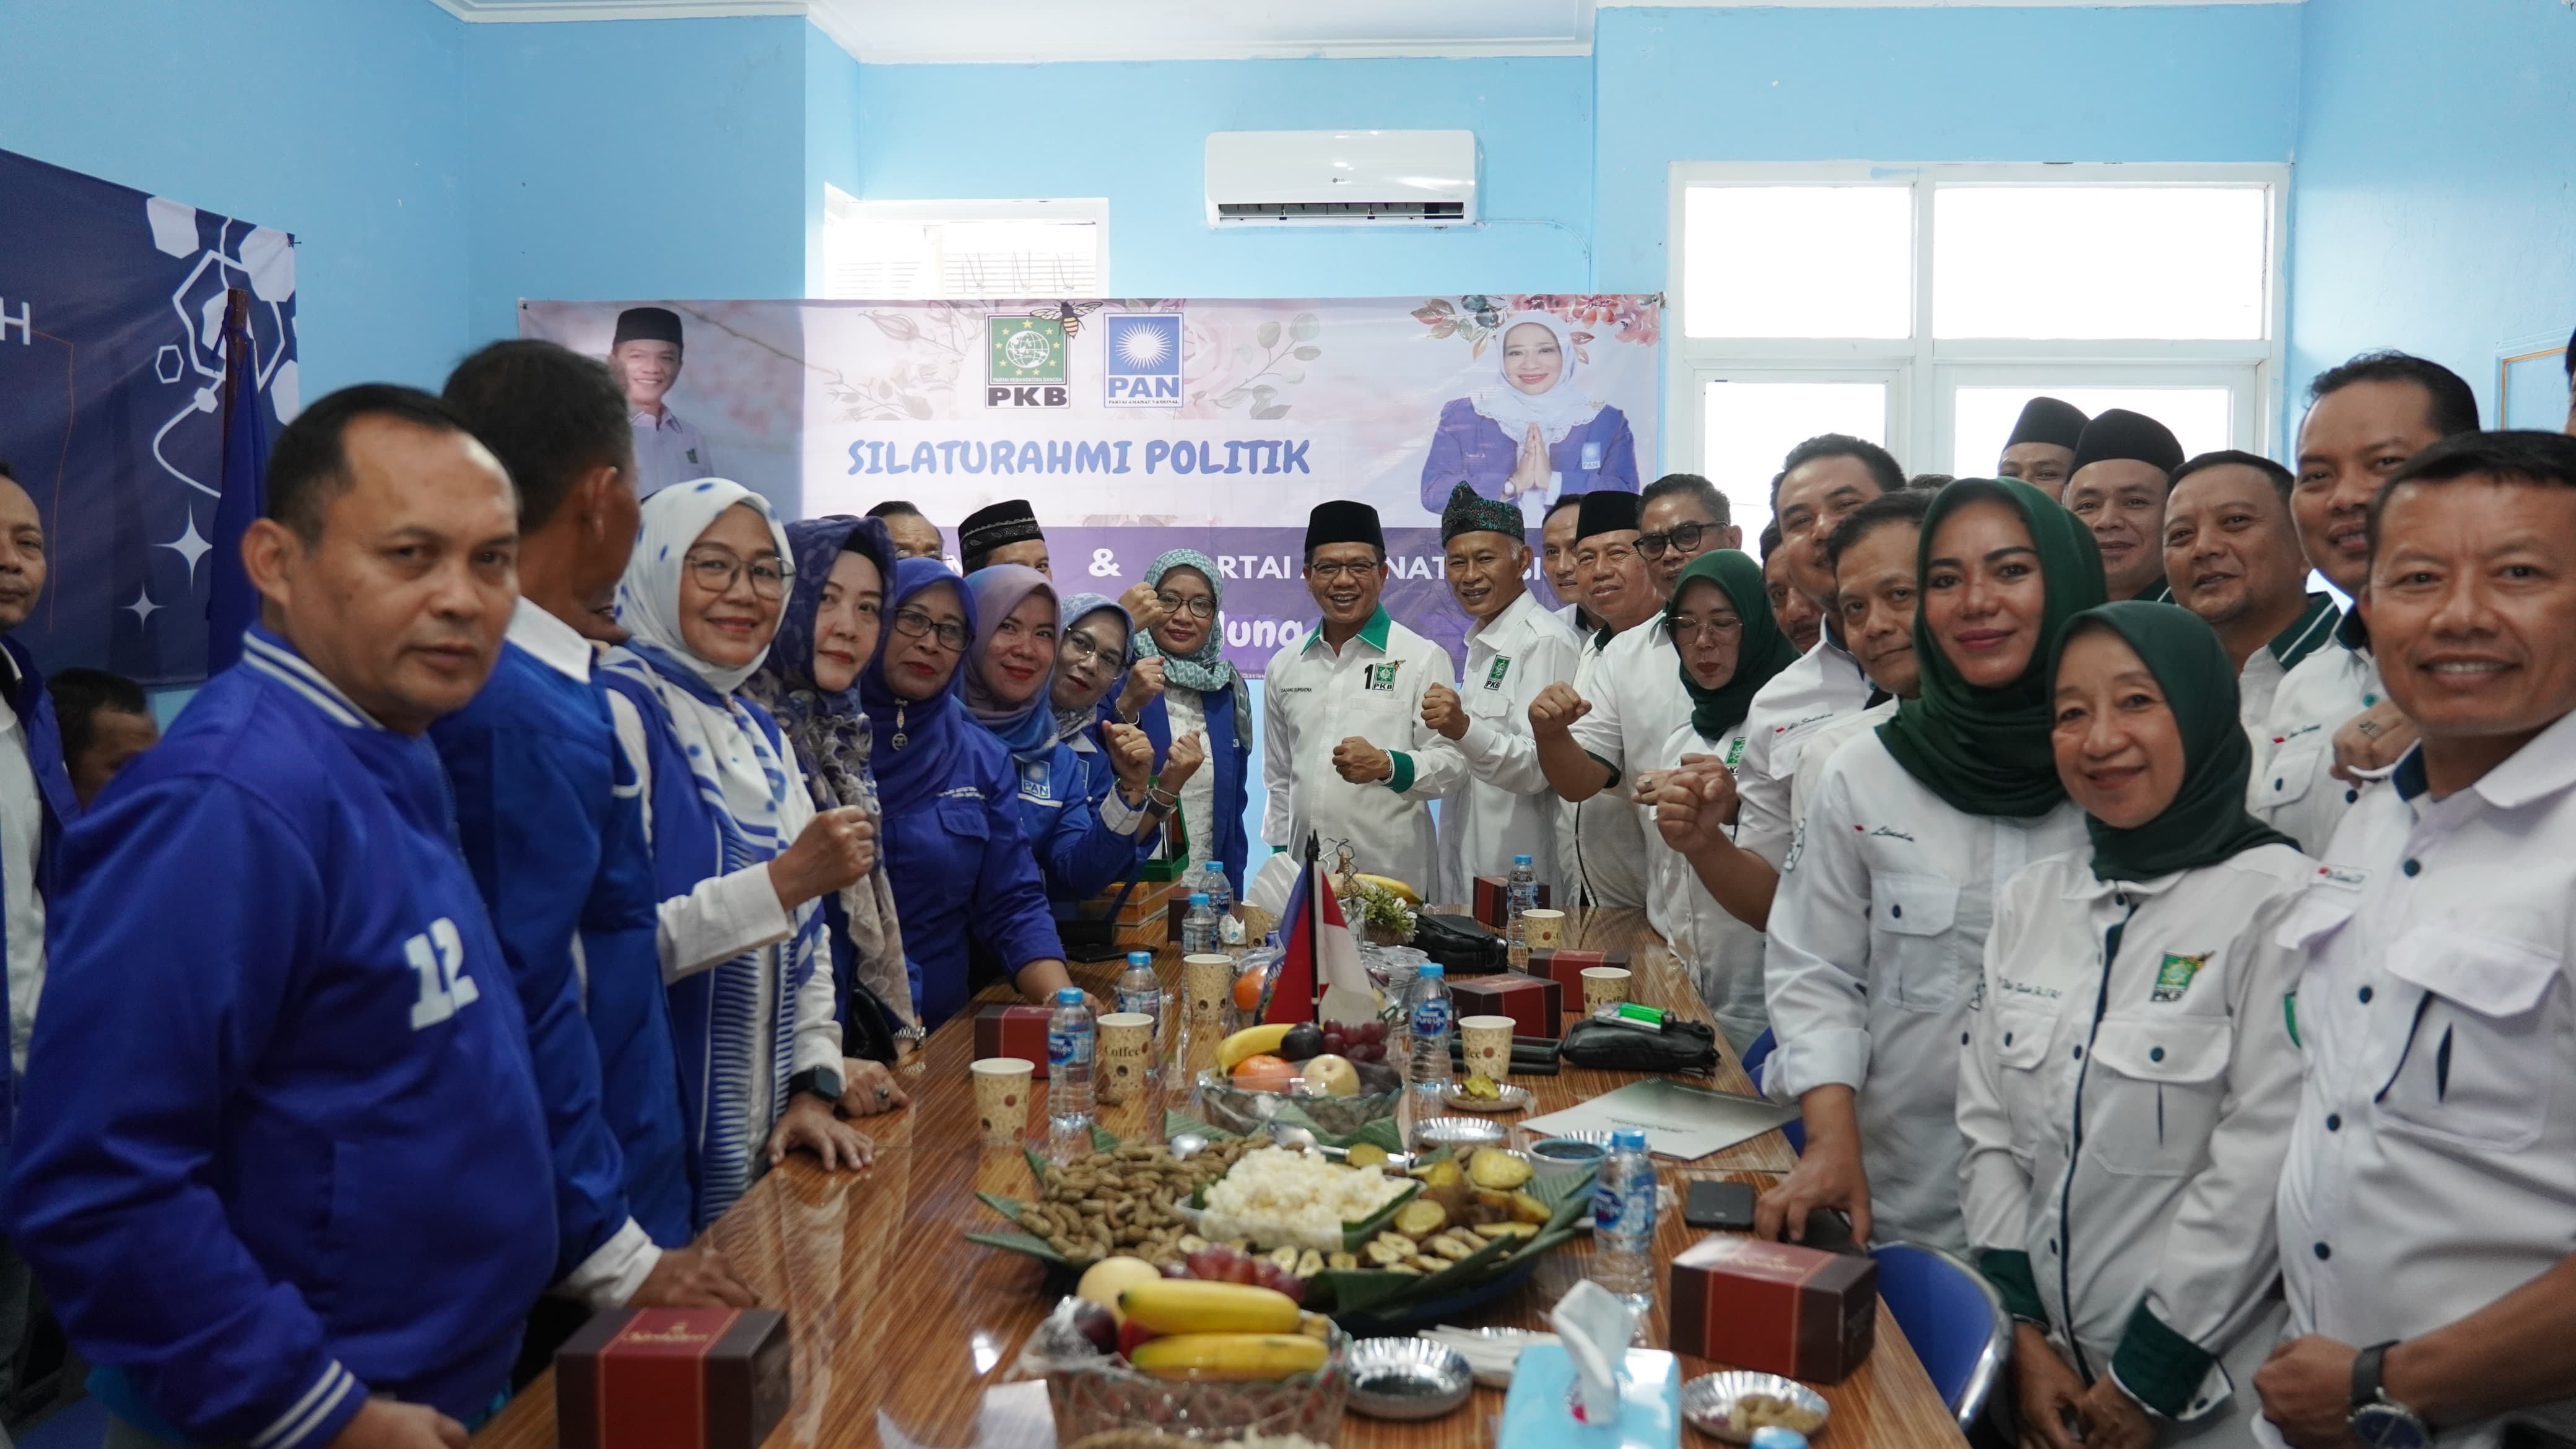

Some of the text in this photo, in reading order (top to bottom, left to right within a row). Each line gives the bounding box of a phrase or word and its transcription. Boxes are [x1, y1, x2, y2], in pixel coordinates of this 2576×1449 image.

[988, 387, 1067, 406] PKB
[1108, 377, 1179, 398] PAN
[848, 439, 1310, 475] SILATURAHMI POLITIK
[1089, 548, 1446, 580] & RTAI NAT
[1486, 680, 1501, 689] PKB
[1024, 781, 1049, 796] PAN
[405, 916, 480, 1032] 12
